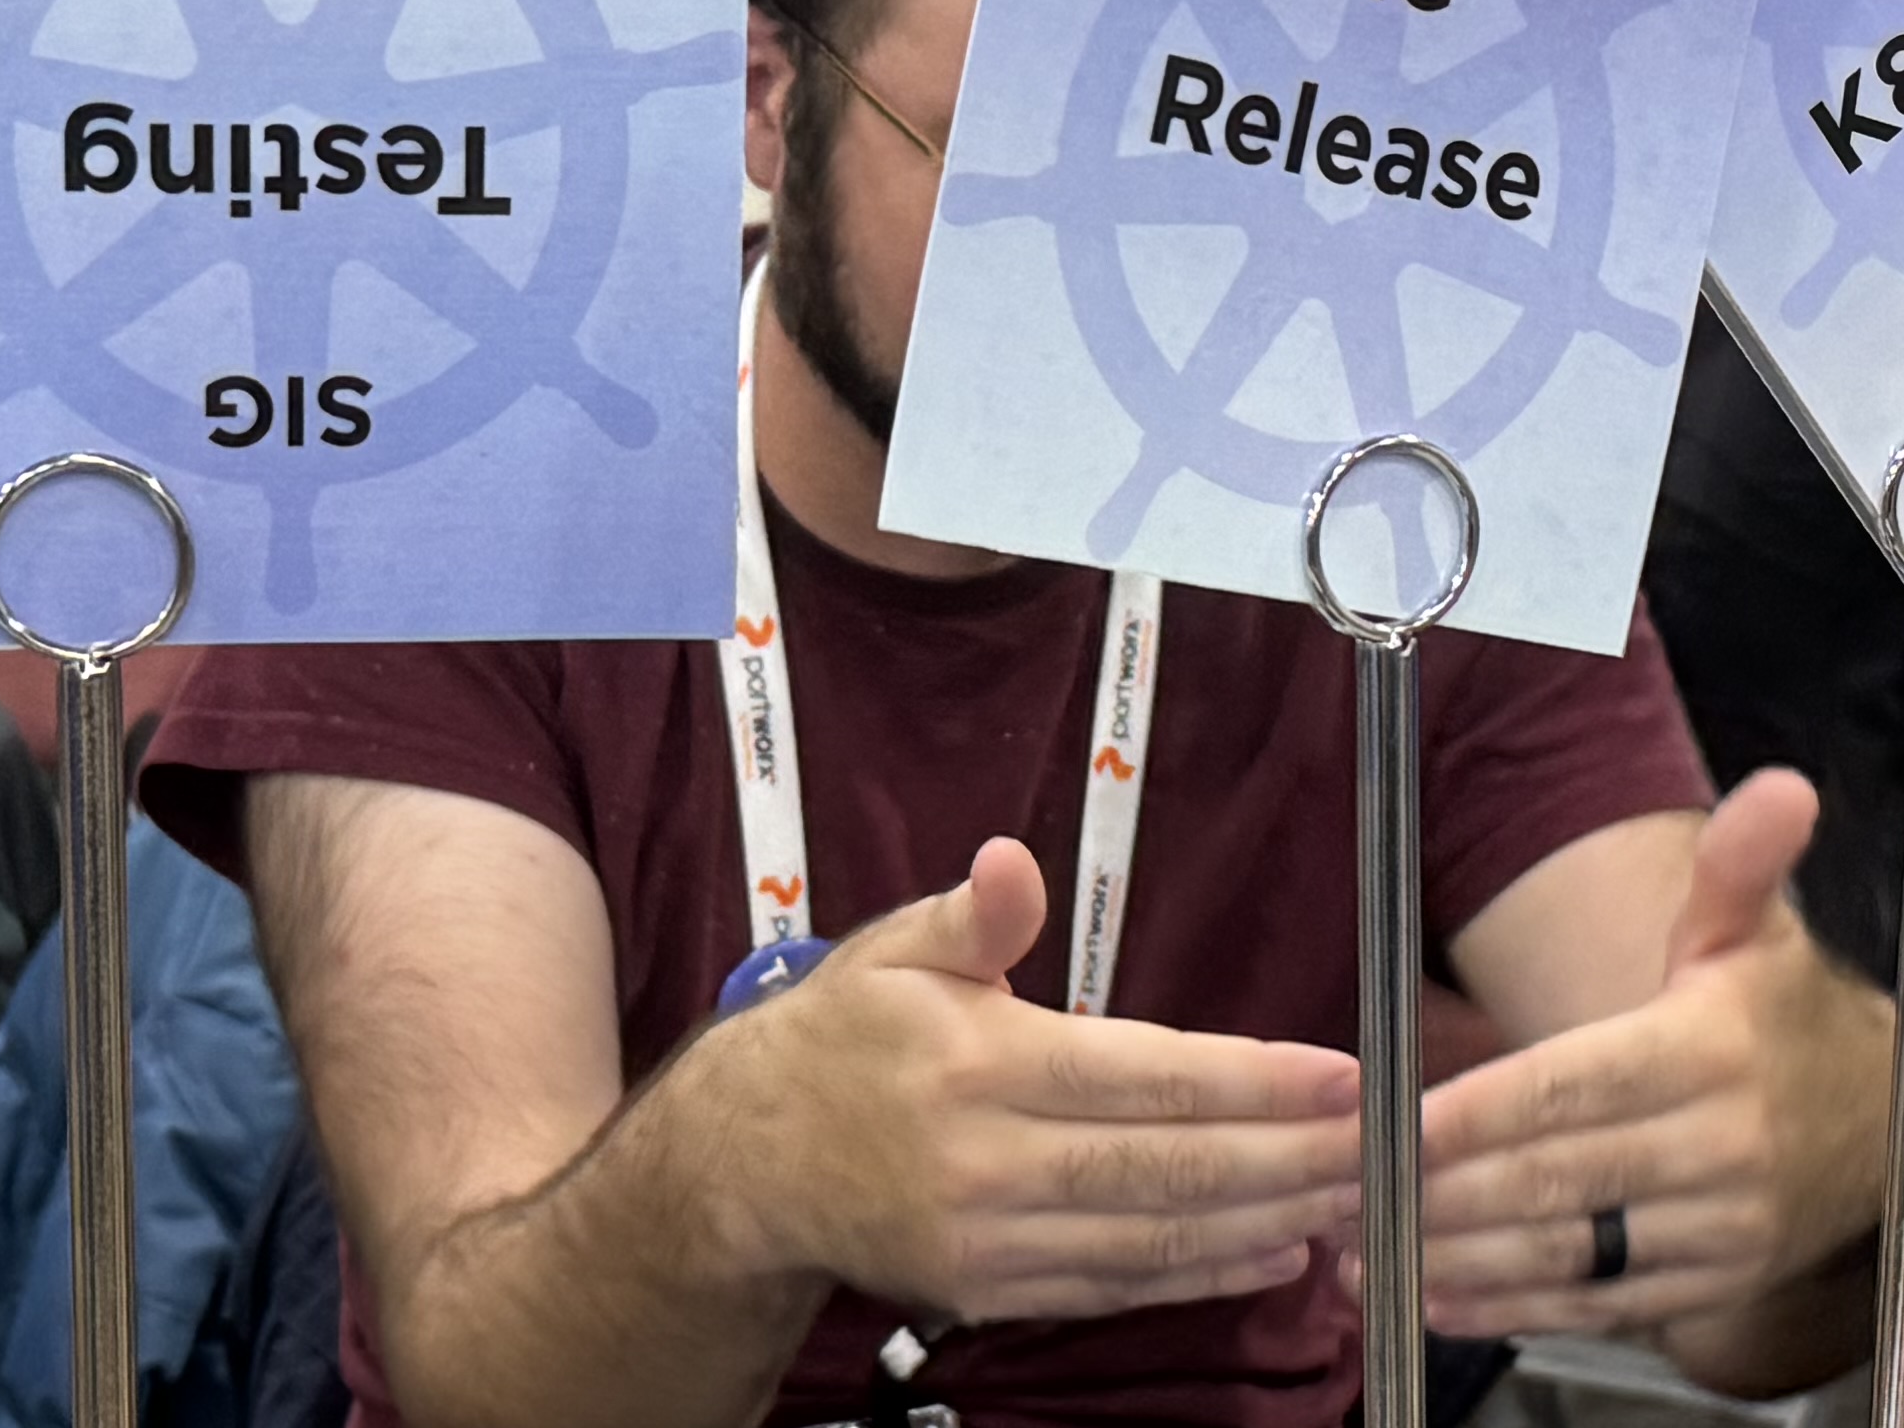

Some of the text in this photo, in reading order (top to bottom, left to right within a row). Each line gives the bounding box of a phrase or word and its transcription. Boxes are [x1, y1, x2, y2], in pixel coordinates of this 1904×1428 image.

[63, 102, 511, 218] Testing
[1150, 53, 1540, 222] Release
[205, 376, 374, 448] SIG
